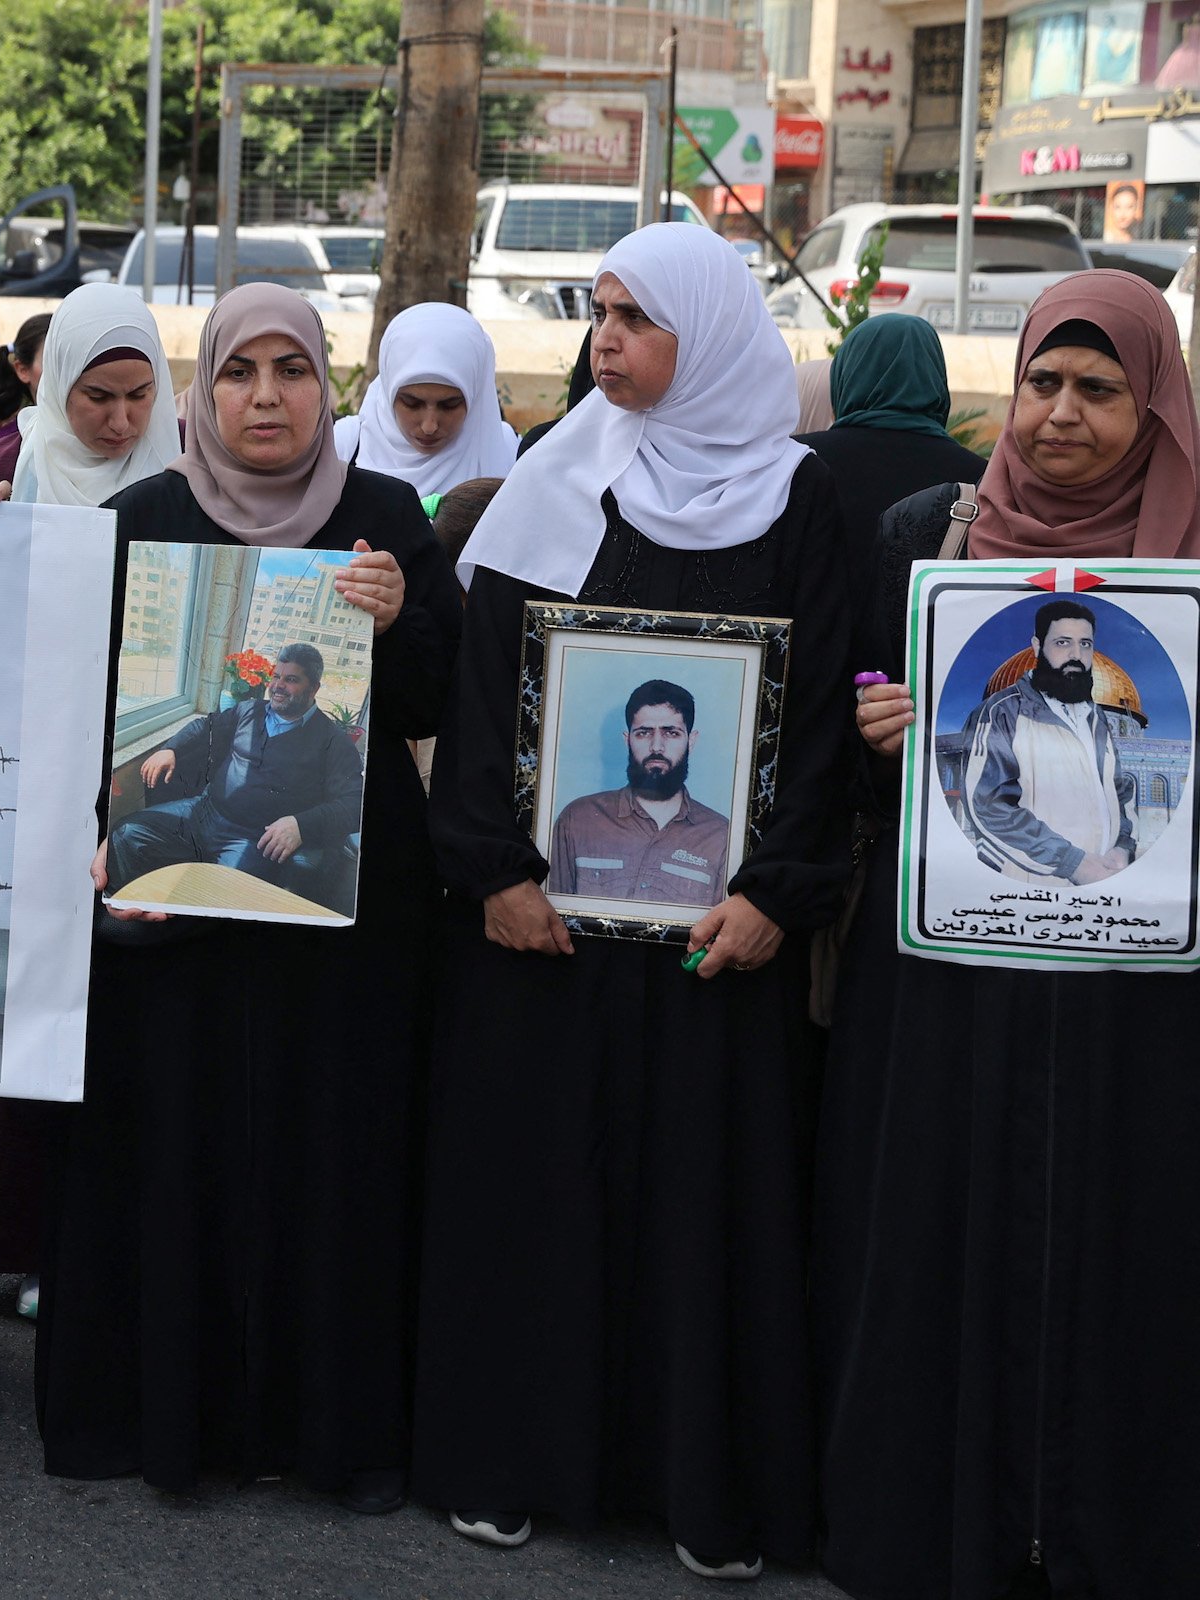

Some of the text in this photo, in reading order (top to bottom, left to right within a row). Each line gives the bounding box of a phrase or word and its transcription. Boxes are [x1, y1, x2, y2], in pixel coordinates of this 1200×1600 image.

[989, 889, 1122, 909] الاسير المقدسي
[951, 905, 1161, 929] محمود موسى عيسى
[932, 917, 1180, 949] عميد الاسرى المعزولين
